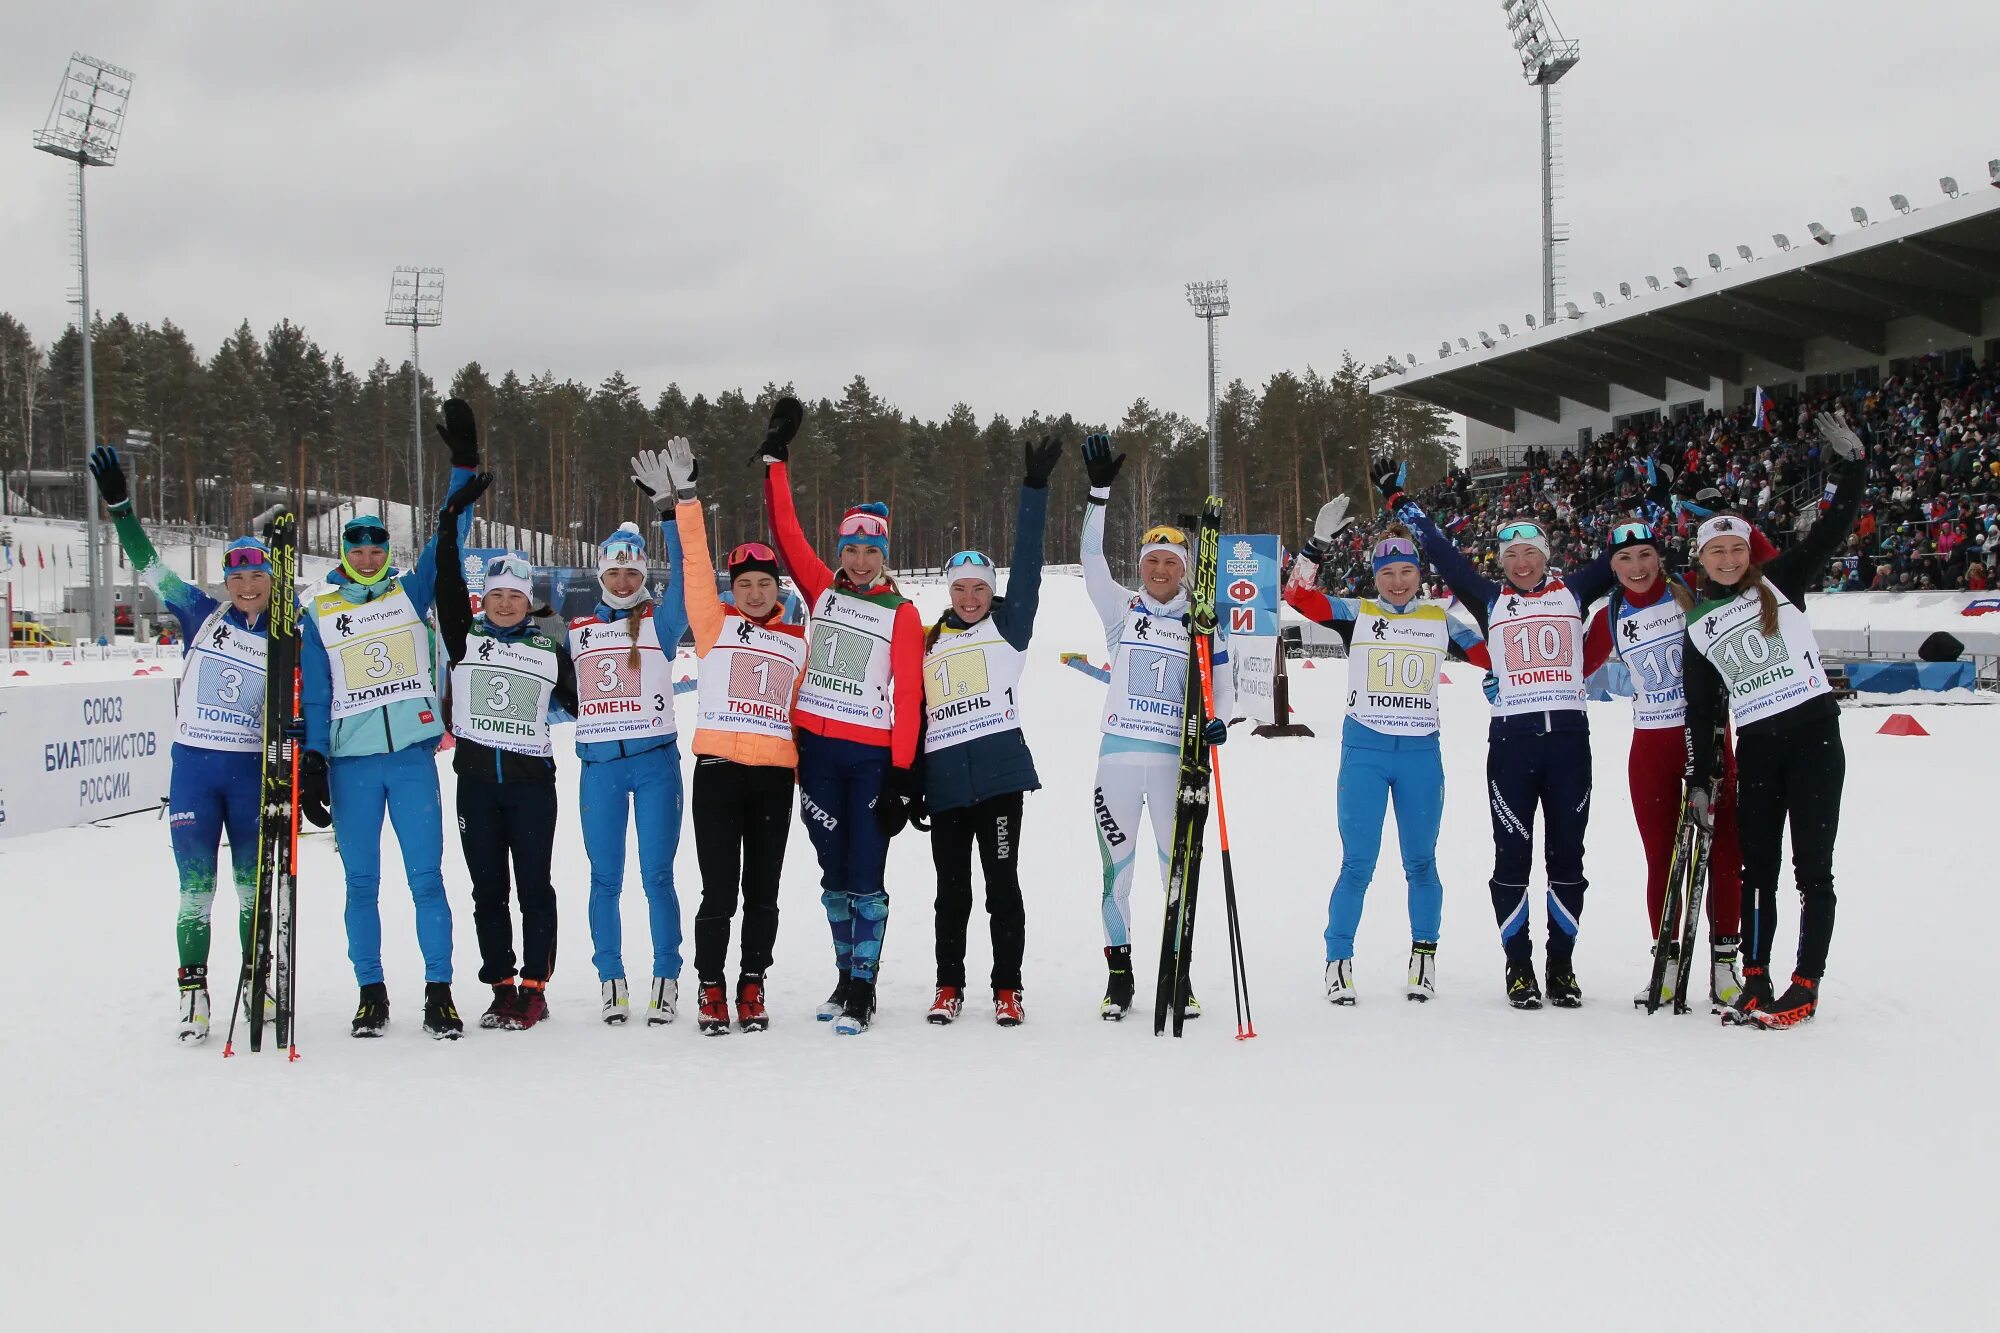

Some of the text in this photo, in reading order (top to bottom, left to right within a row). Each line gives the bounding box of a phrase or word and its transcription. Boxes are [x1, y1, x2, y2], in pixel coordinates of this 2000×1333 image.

[271, 547, 281, 640] FISCHER
[284, 544, 294, 637] FISCHER
[358, 608, 403, 624] VisitTyumen
[837, 605, 880, 624] VisitTyumen
[1393, 627, 1435, 638] VisitTyumen
[1513, 624, 1562, 663] 10
[364, 641, 392, 678] 3
[498, 648, 543, 666] VisitTyumen
[824, 632, 839, 668] 1
[1724, 628, 1770, 675] 10
[596, 657, 618, 692] 3
[753, 660, 769, 695] 1
[934, 659, 968, 697] 1 3
[1150, 656, 1168, 693] 1
[1378, 651, 1425, 689] 10
[1508, 669, 1572, 687] ТЮМЕНЬ
[217, 667, 244, 703] 3
[486, 675, 512, 711] 3
[807, 671, 863, 697] ТЮМЕНЬ
[1004, 686, 1014, 705] 1
[1775, 685, 1809, 702] СИБИРИ
[84, 696, 122, 725] СОЮЗ
[653, 693, 665, 712] 3
[837, 705, 869, 718] СИБИРИ
[931, 696, 991, 722] ТЮМЕНЬ
[1368, 695, 1432, 710] ТЮМЕНЬ
[1506, 696, 1553, 707] ЖЕМЧУЖИНА
[197, 707, 261, 729] ТЮМЕНЬ
[470, 717, 536, 737] ТЮМЕНЬ
[619, 723, 650, 732] СИБИРИ
[718, 714, 767, 727] ЖЕМЧУЖИНА
[969, 717, 1004, 732] СИБИРИ
[1120, 722, 1164, 735] ЖЕМЧУЖИНА
[1411, 721, 1436, 729] СИБИРИ
[1640, 711, 1686, 722] ЖЕМЧУЖИНА
[187, 731, 237, 744] ЖЕМЧУЖИНА
[45, 731, 156, 772] БИАТЛОНИСТОВ
[80, 771, 130, 807] РОССИИ
[1491, 779, 1530, 841] НОВОСИБИРСКАЯ
[1492, 799, 1514, 834] ОБЛАСТЬ
